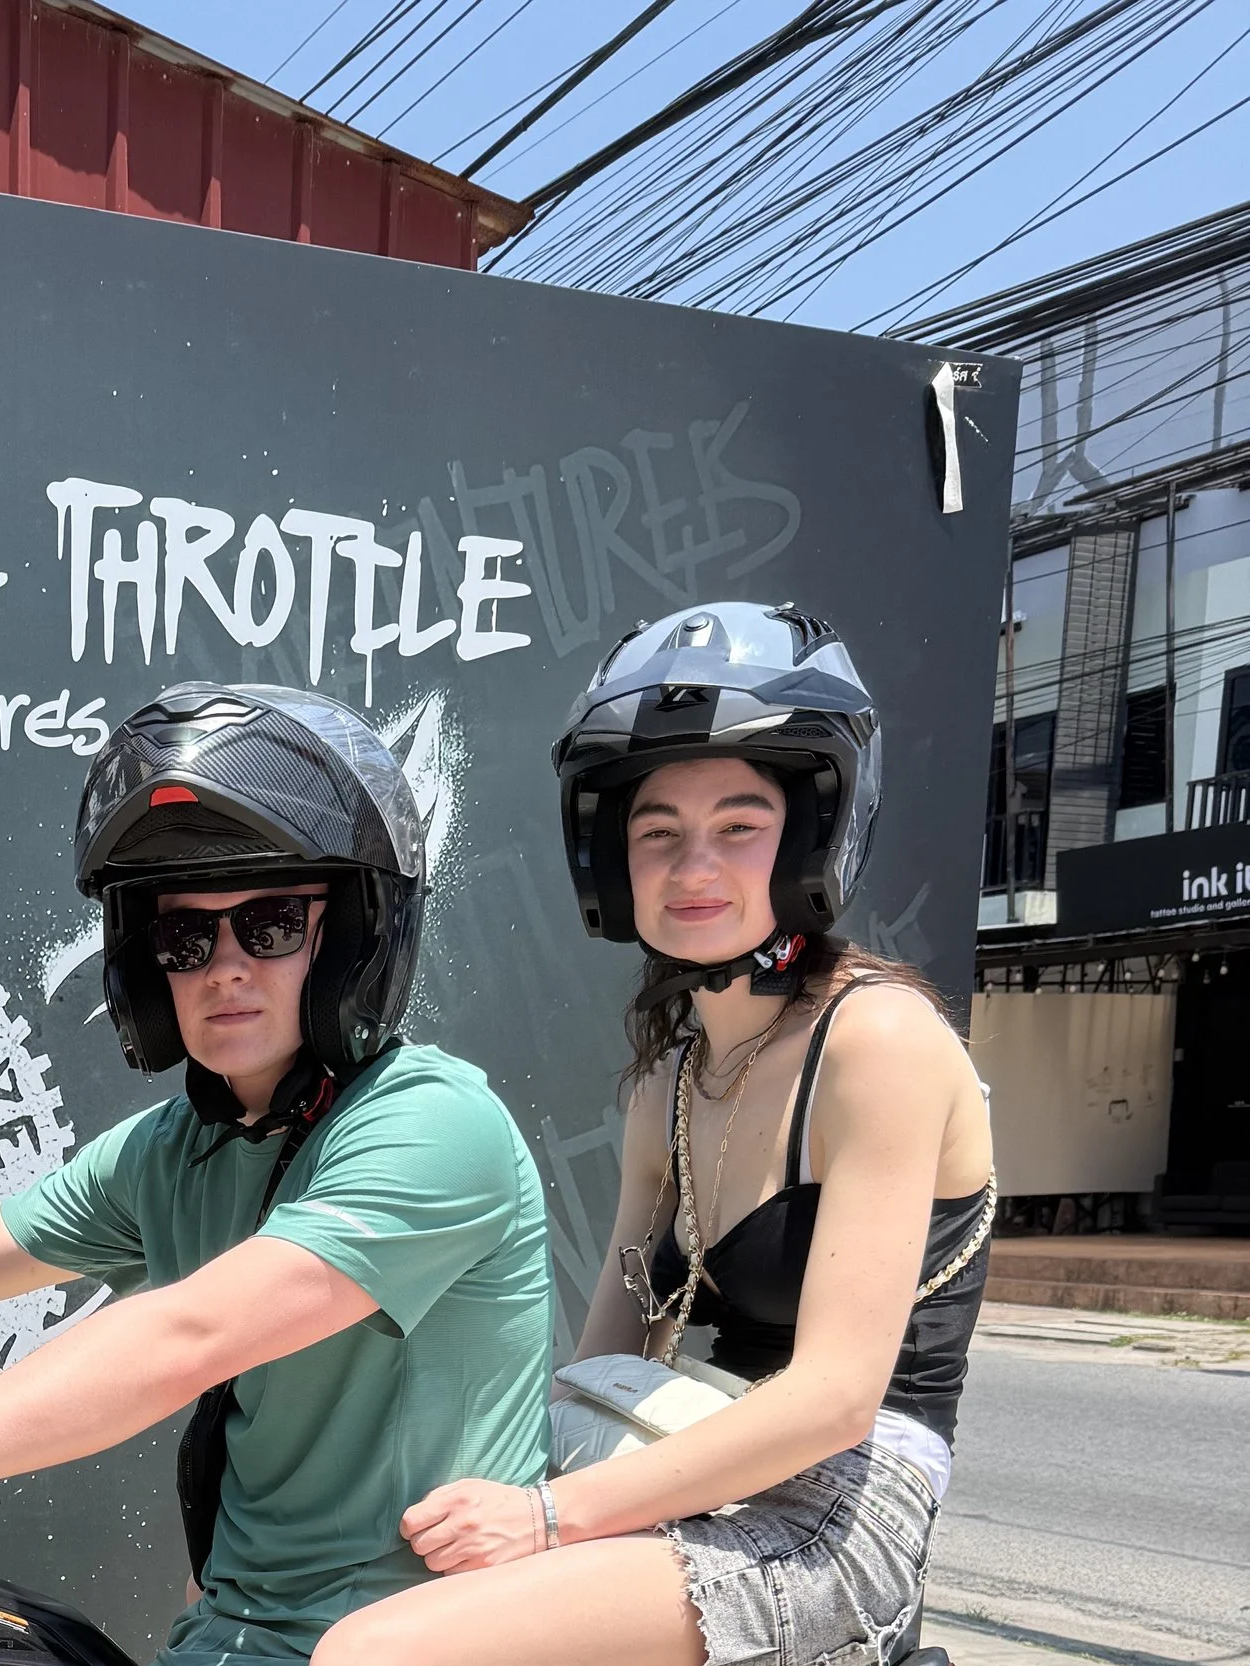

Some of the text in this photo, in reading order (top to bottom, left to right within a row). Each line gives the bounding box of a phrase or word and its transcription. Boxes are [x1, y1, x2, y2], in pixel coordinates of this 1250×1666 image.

[46, 477, 532, 690] THROTTLE
[1182, 866, 1228, 901] ink
[1150, 907, 1177, 918] tattoo
[1178, 903, 1205, 915] studio
[1207, 900, 1224, 911] and
